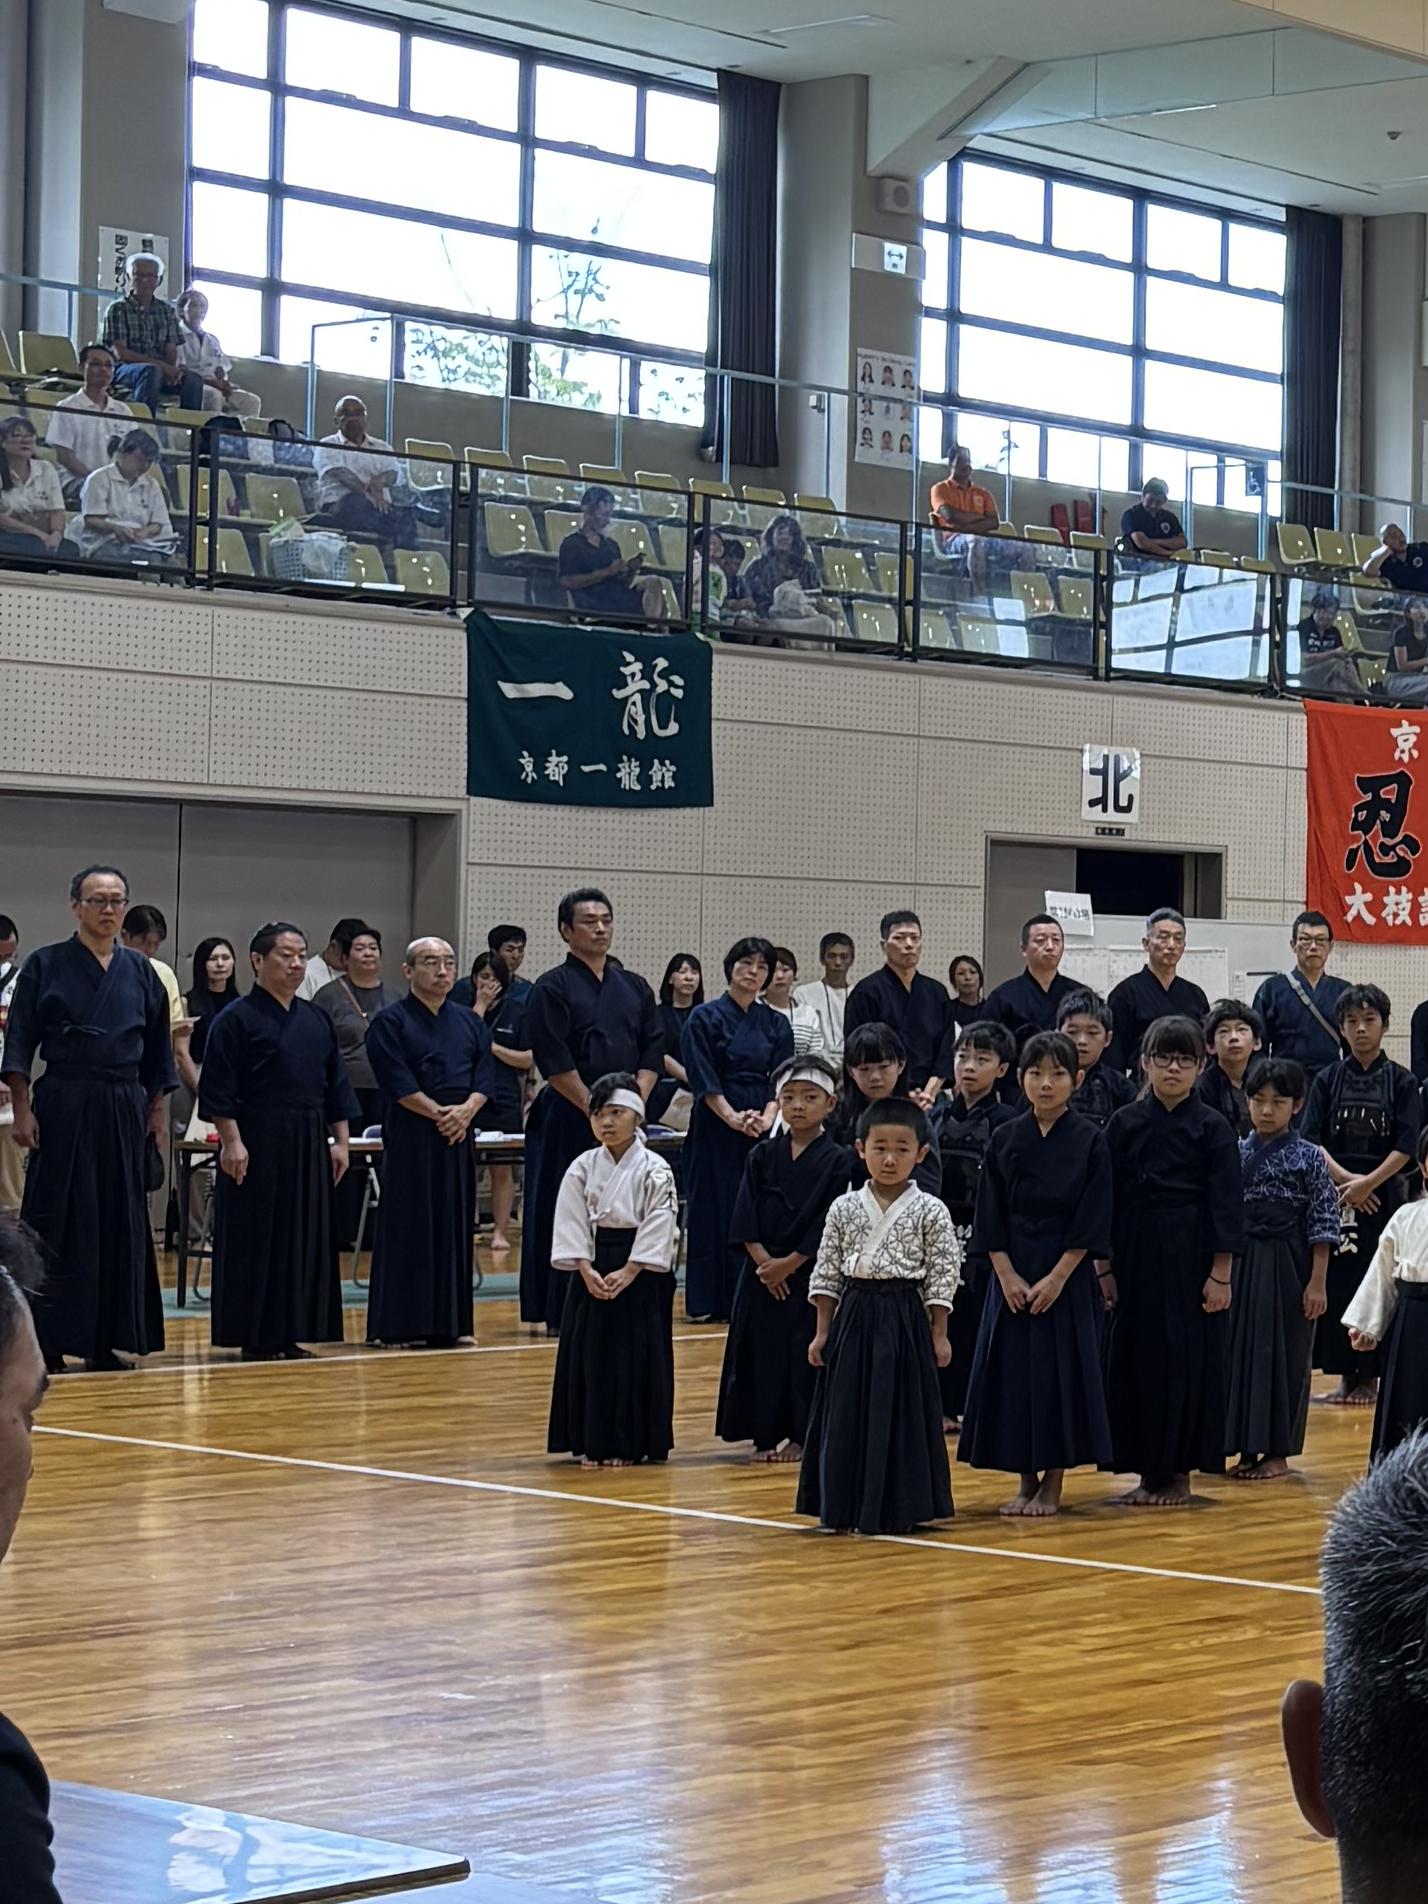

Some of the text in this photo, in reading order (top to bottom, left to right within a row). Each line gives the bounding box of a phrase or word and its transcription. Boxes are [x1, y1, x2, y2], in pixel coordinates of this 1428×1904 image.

[518, 749, 677, 791] 京都一龍館
[1088, 754, 1134, 814] 北
